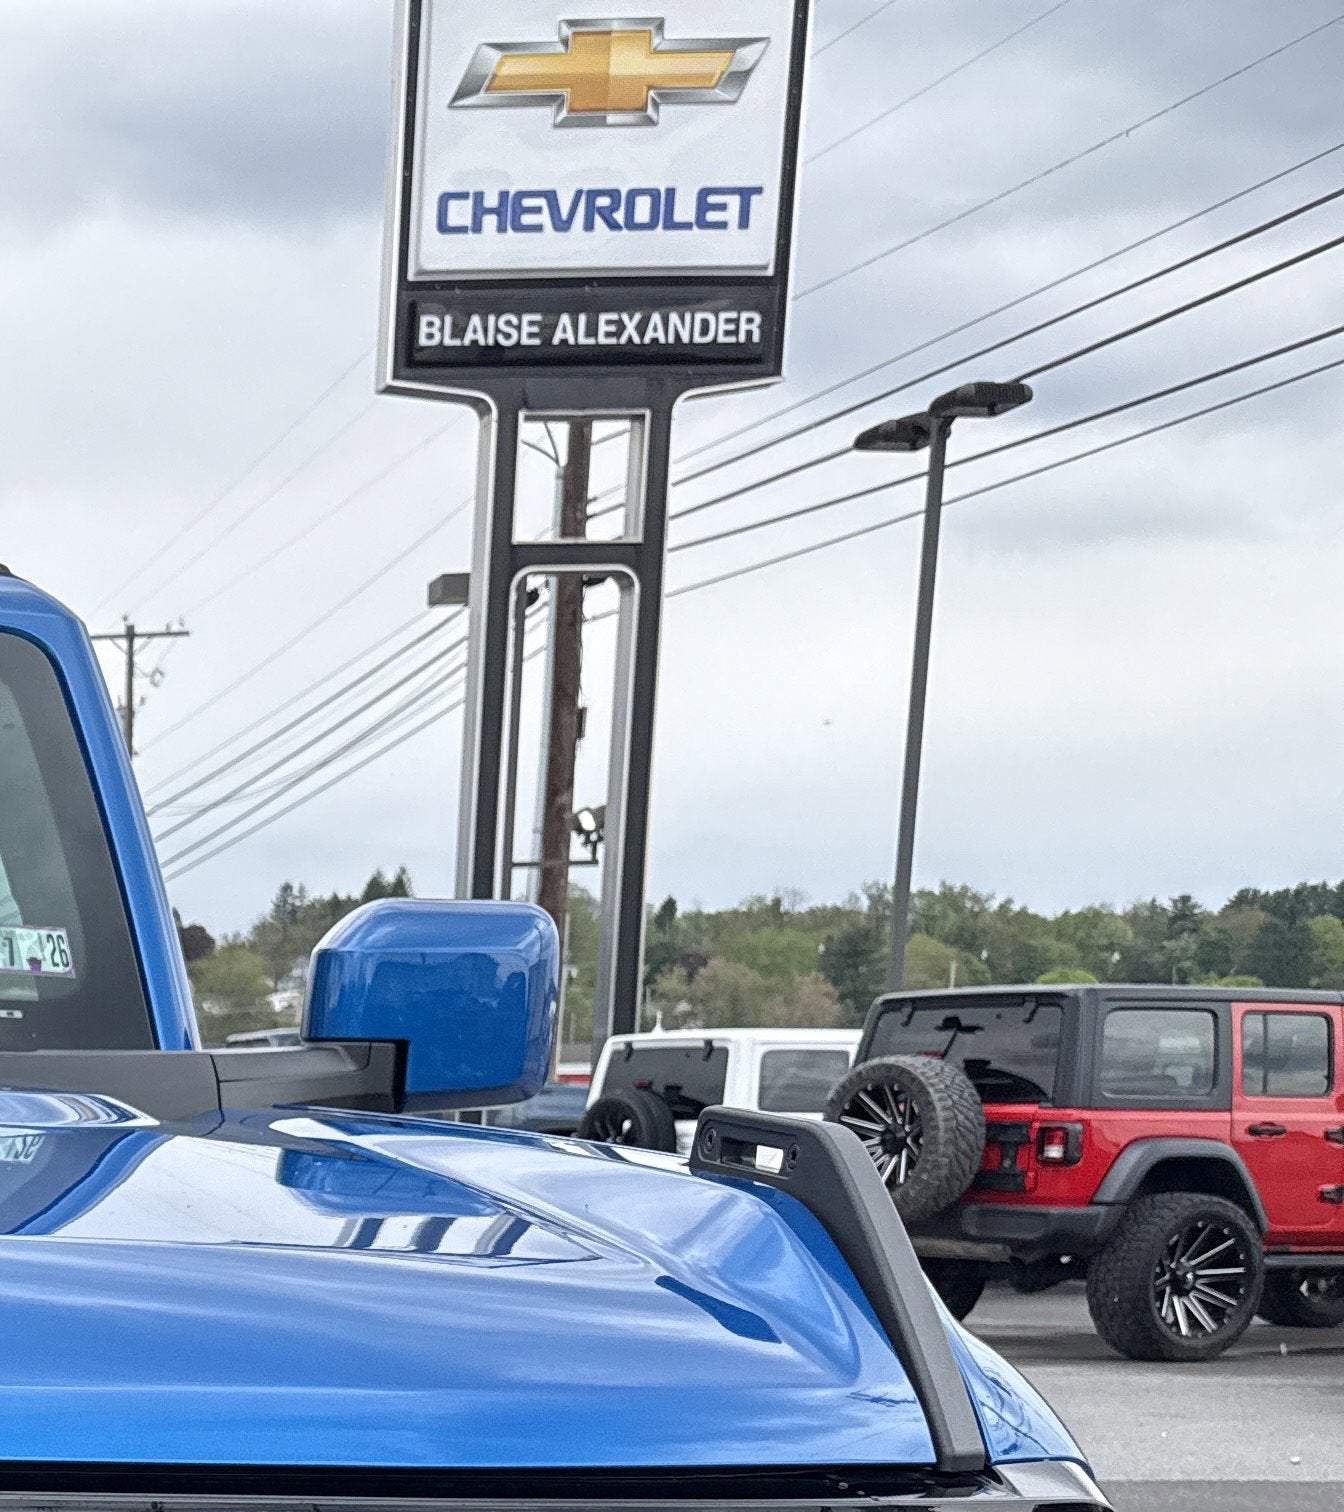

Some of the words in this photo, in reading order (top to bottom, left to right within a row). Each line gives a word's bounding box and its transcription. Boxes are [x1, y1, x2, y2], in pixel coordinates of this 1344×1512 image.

[436, 186, 764, 235] CHEVROLET
[418, 313, 542, 347] BLAISE
[552, 311, 761, 345] ALEXANDER
[46, 933, 70, 968] 26
